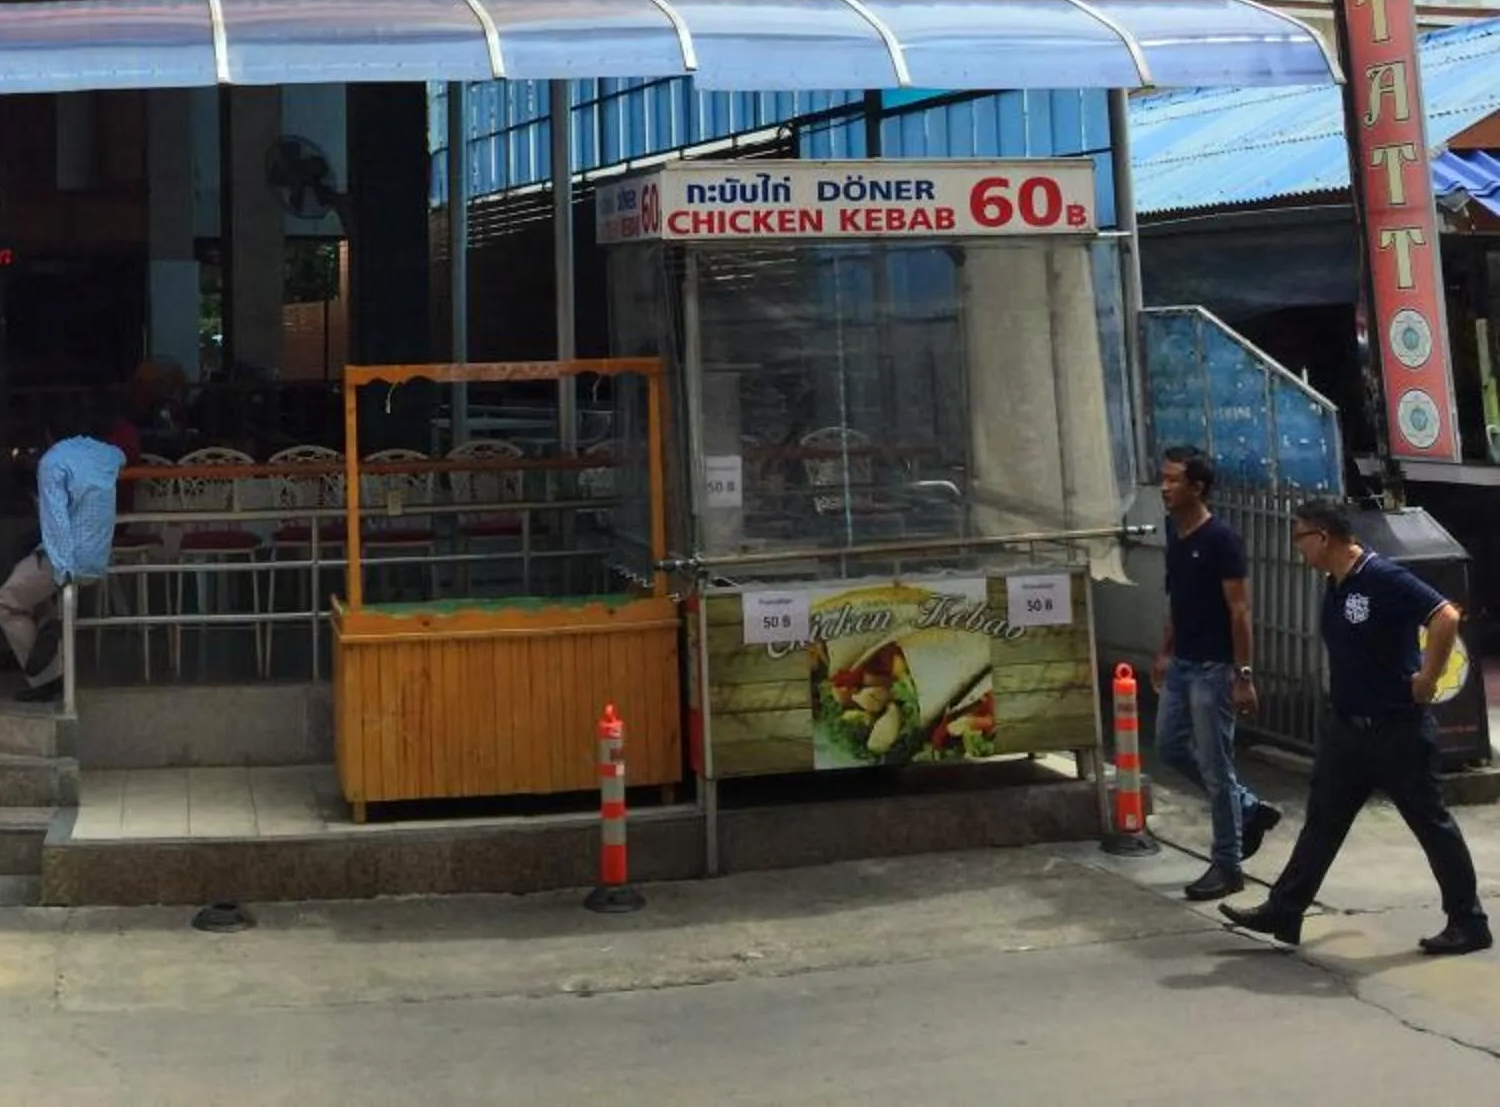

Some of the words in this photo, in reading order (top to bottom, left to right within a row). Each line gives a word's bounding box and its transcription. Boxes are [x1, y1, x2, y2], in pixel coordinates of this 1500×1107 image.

[817, 175, 936, 202] DÖNER
[641, 182, 659, 234] 60
[667, 209, 824, 235] CHICKEN
[839, 207, 956, 232] KEBAB
